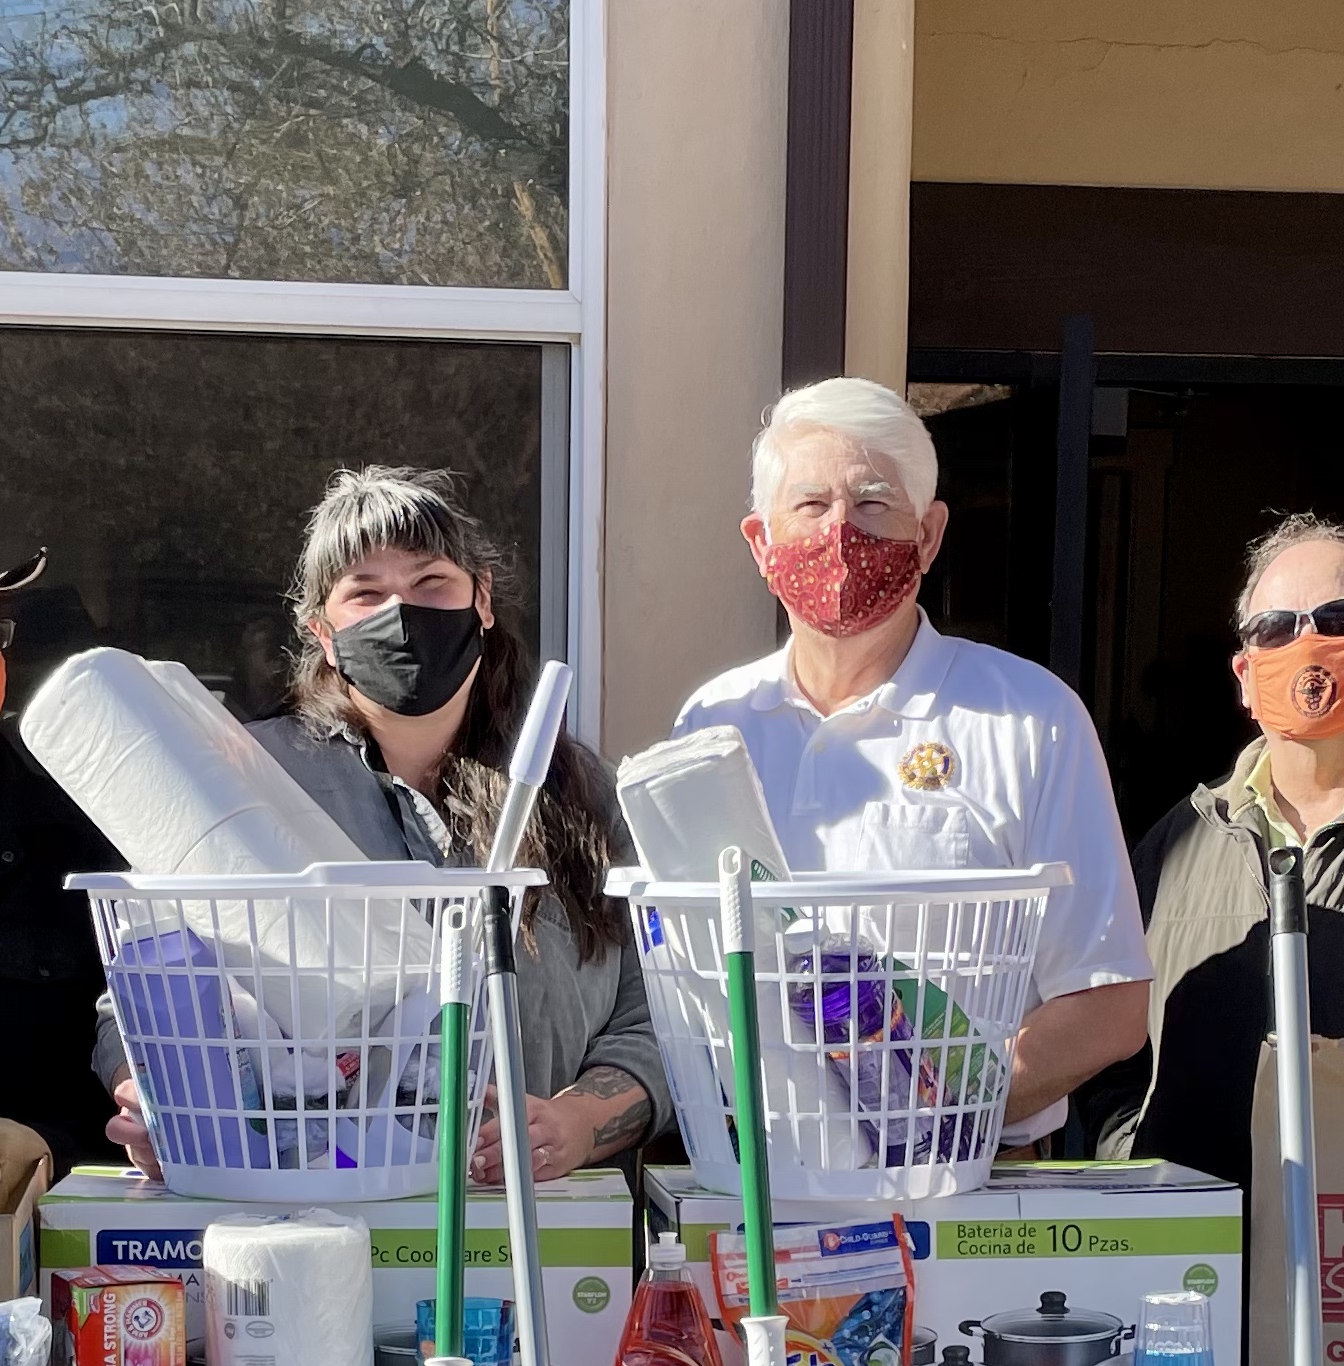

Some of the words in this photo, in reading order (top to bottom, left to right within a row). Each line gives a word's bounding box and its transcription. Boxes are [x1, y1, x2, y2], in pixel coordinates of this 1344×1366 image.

[956, 1223, 1013, 1239] Batería
[1017, 1223, 1037, 1239] de
[1046, 1223, 1083, 1253] 10
[1088, 1235, 1134, 1253] Pzas.
[112, 1239, 204, 1261] TRAMO
[956, 1240, 1012, 1256] Cocina
[1016, 1240, 1036, 1255] de
[103, 1292, 117, 1351] STRONG
